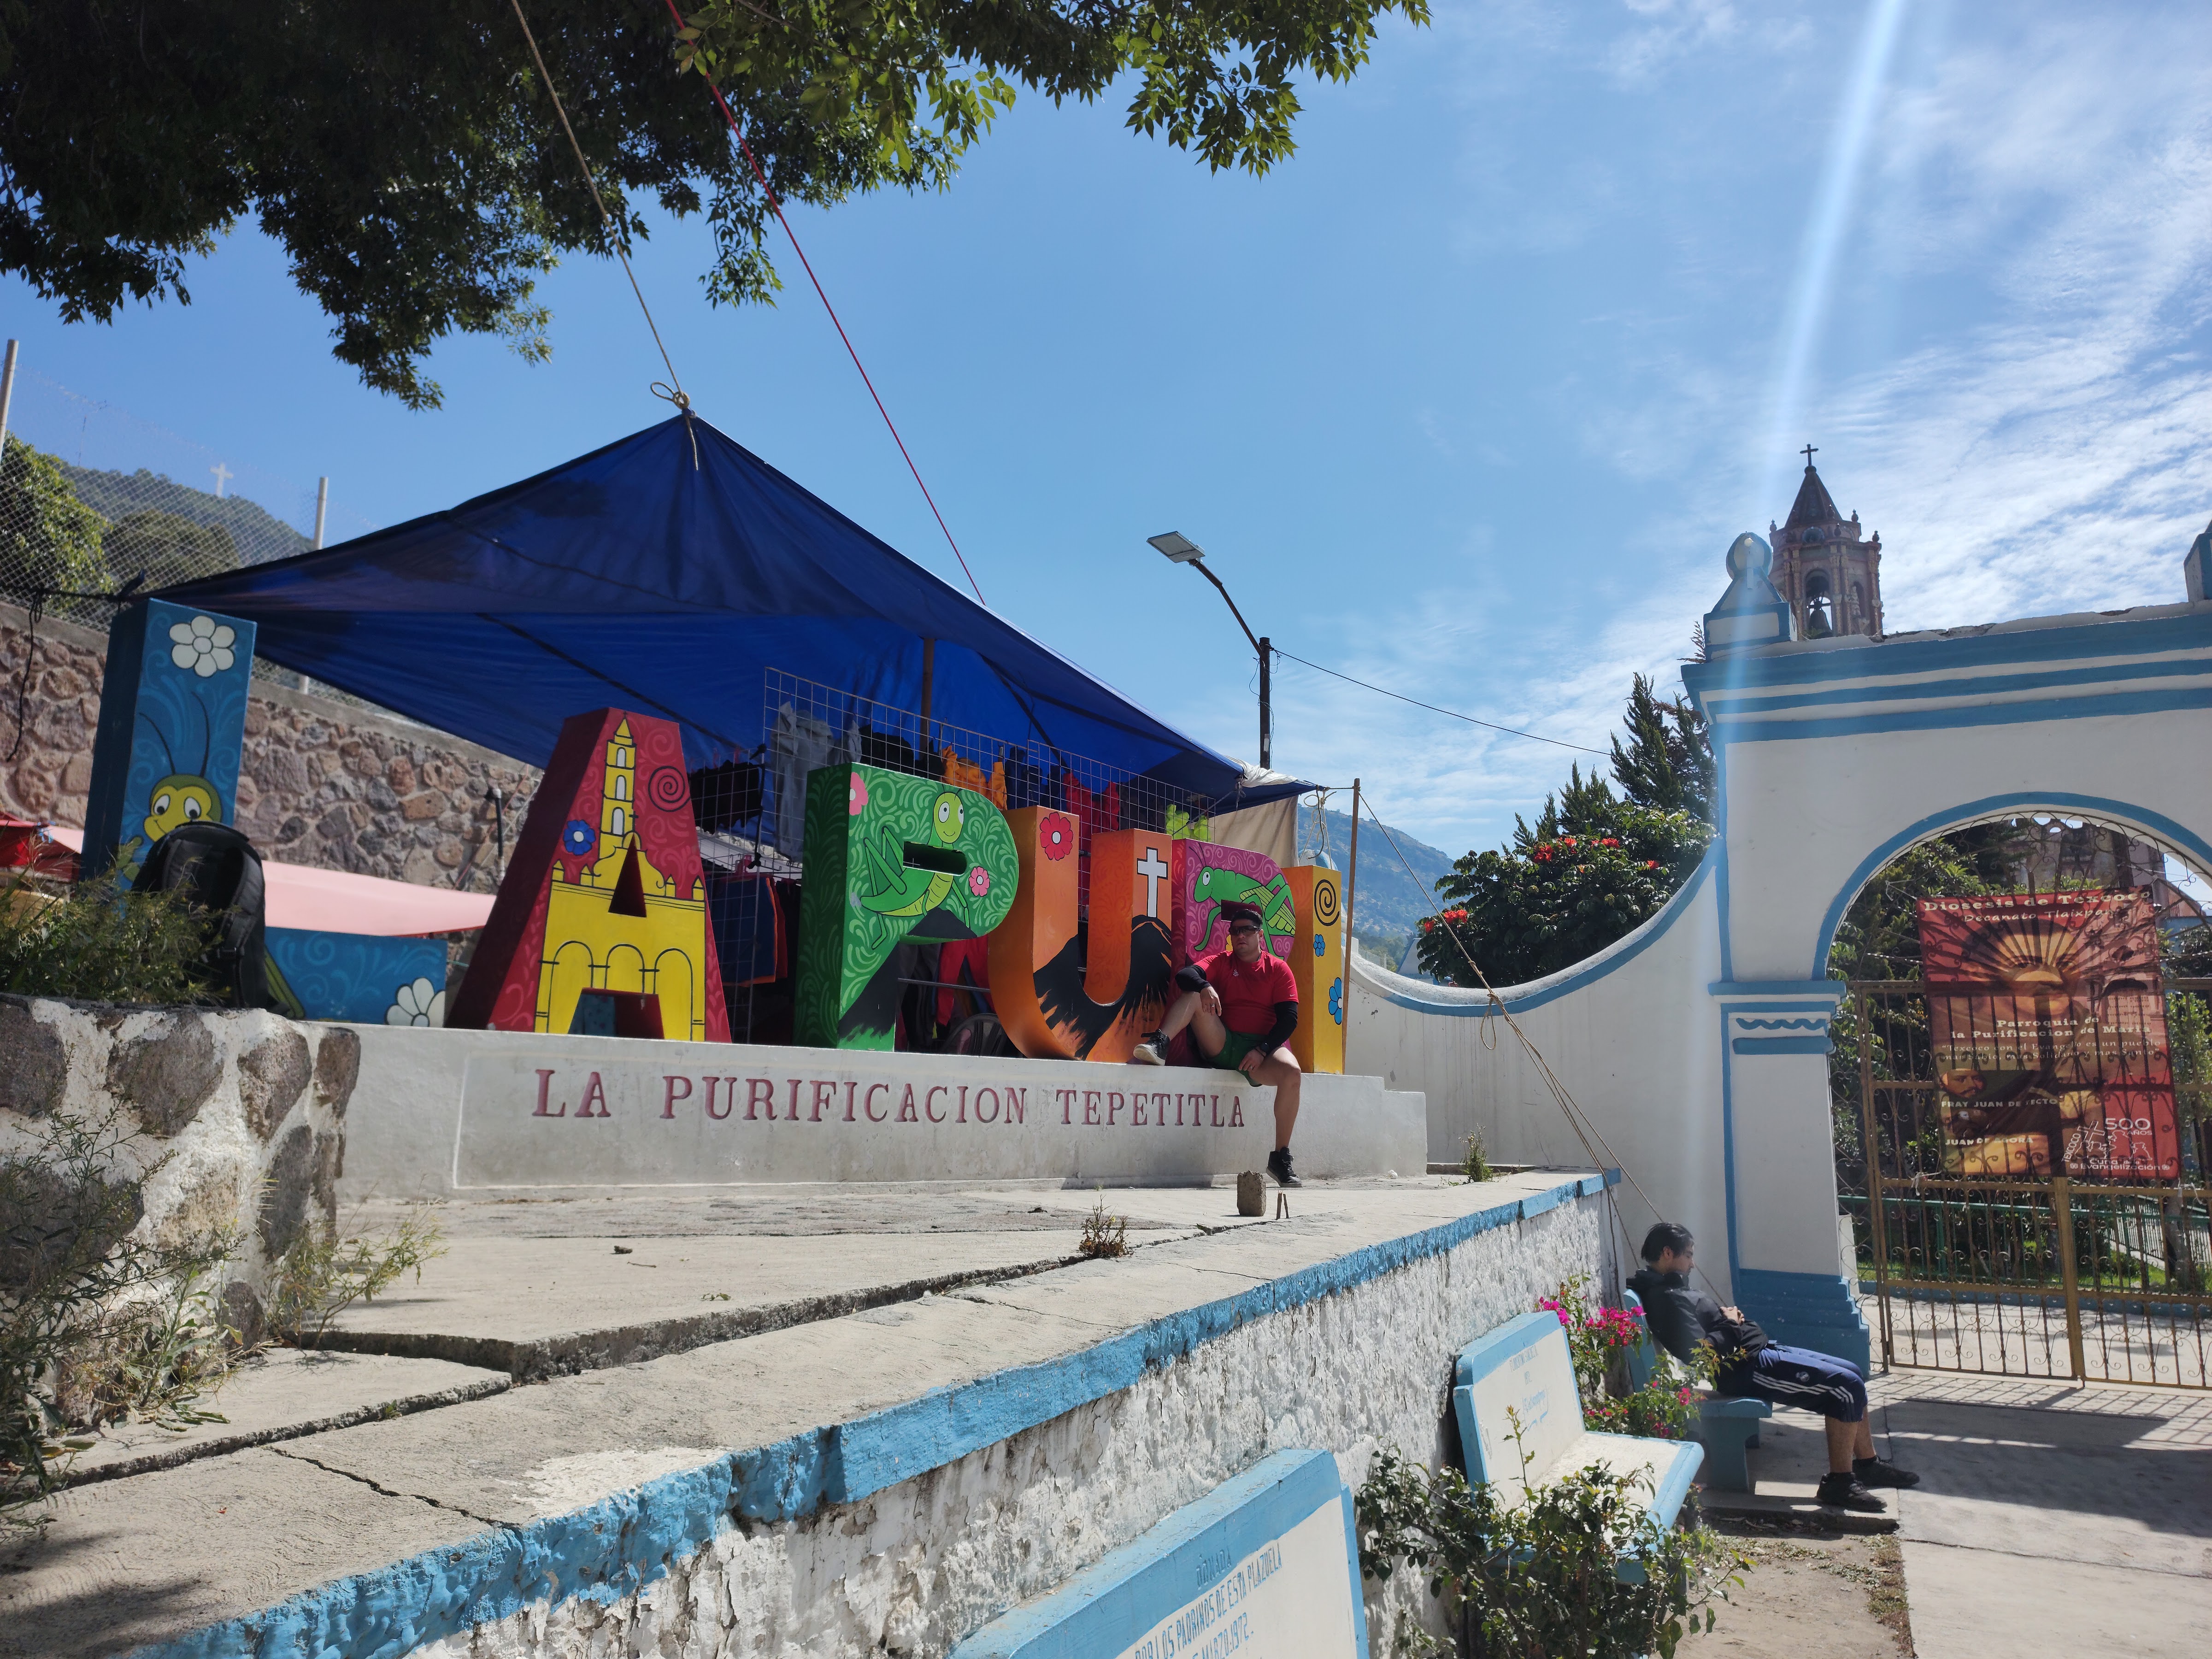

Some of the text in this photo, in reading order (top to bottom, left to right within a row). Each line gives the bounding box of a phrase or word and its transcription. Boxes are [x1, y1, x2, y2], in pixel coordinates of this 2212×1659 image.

[1924, 891, 2150, 911] Diosesis de Texcoco
[1964, 909, 2114, 922] Decanato Tlaixpan
[1996, 1018, 2078, 1028] Parroquia
[1972, 1029, 2074, 1038] Purificacion
[2102, 1025, 2151, 1034] Maria
[2122, 1038, 2160, 1048] pueblo
[532, 1069, 1246, 1128] LA PURIFICACION TEPETITLA
[2105, 1118, 2151, 1130] 500
[2080, 1162, 2160, 1171] Evangelización
[1196, 1546, 1232, 1590] DONADA
[1176, 1594, 1216, 1652] PADRINOS
[1216, 1585, 1227, 1618] DE
[1227, 1571, 1247, 1609] ESTA
[1247, 1542, 1282, 1593] PLAZUELA
